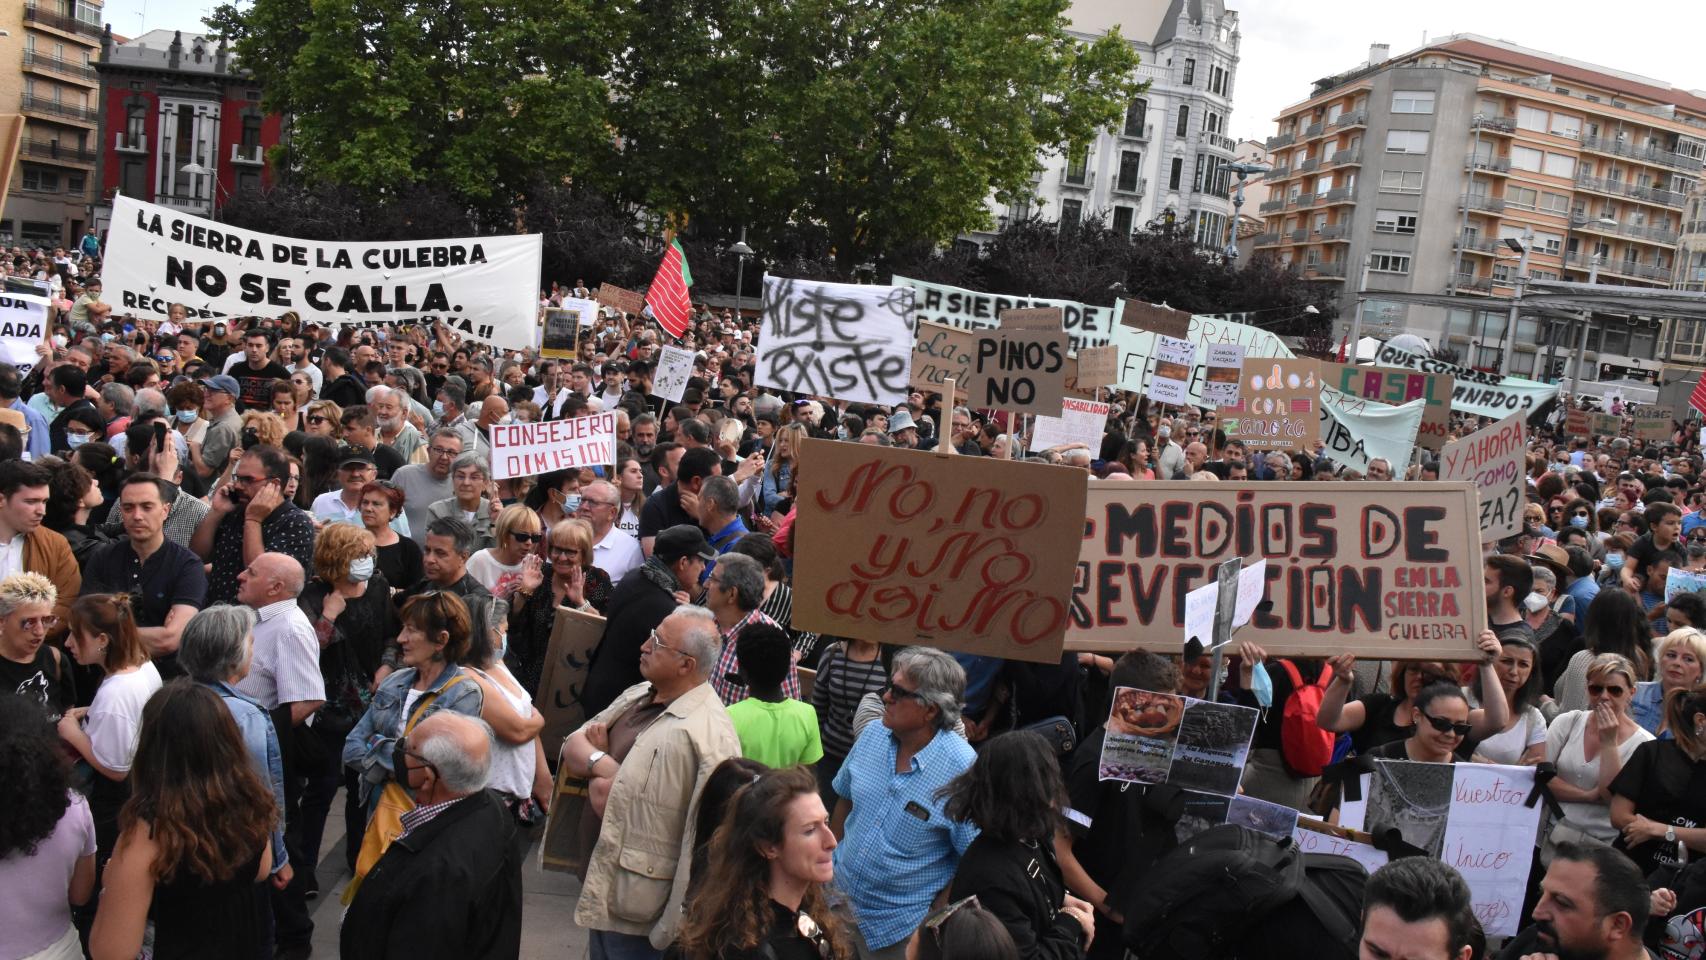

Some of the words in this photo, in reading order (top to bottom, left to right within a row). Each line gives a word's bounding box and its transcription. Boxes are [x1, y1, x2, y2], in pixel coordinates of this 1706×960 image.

[137, 209, 163, 236] LA
[171, 219, 264, 260] SIERRA
[272, 243, 307, 266] DE
[316, 248, 353, 269] LA
[362, 244, 487, 269] CULEBRA
[166, 255, 227, 298] NO
[240, 273, 291, 307] SE
[304, 282, 463, 313] CALLA.
[1, 322, 41, 338] ADA
[1063, 305, 1098, 331] DE
[986, 377, 1036, 406] NO
[1340, 367, 1443, 406] CASAL
[494, 414, 614, 448] CONSEJERO
[507, 441, 612, 477] DIMISION
[1447, 450, 1459, 479] Y
[1461, 421, 1523, 475] AHORA
[952, 487, 1044, 531] no
[1360, 504, 1450, 564] DE
[1395, 566, 1427, 588] EN
[1429, 566, 1462, 588] LA
[1384, 591, 1461, 618] SIERRA
[1389, 622, 1467, 641] CULEBRA
[1455, 777, 1525, 805] Vuestro
